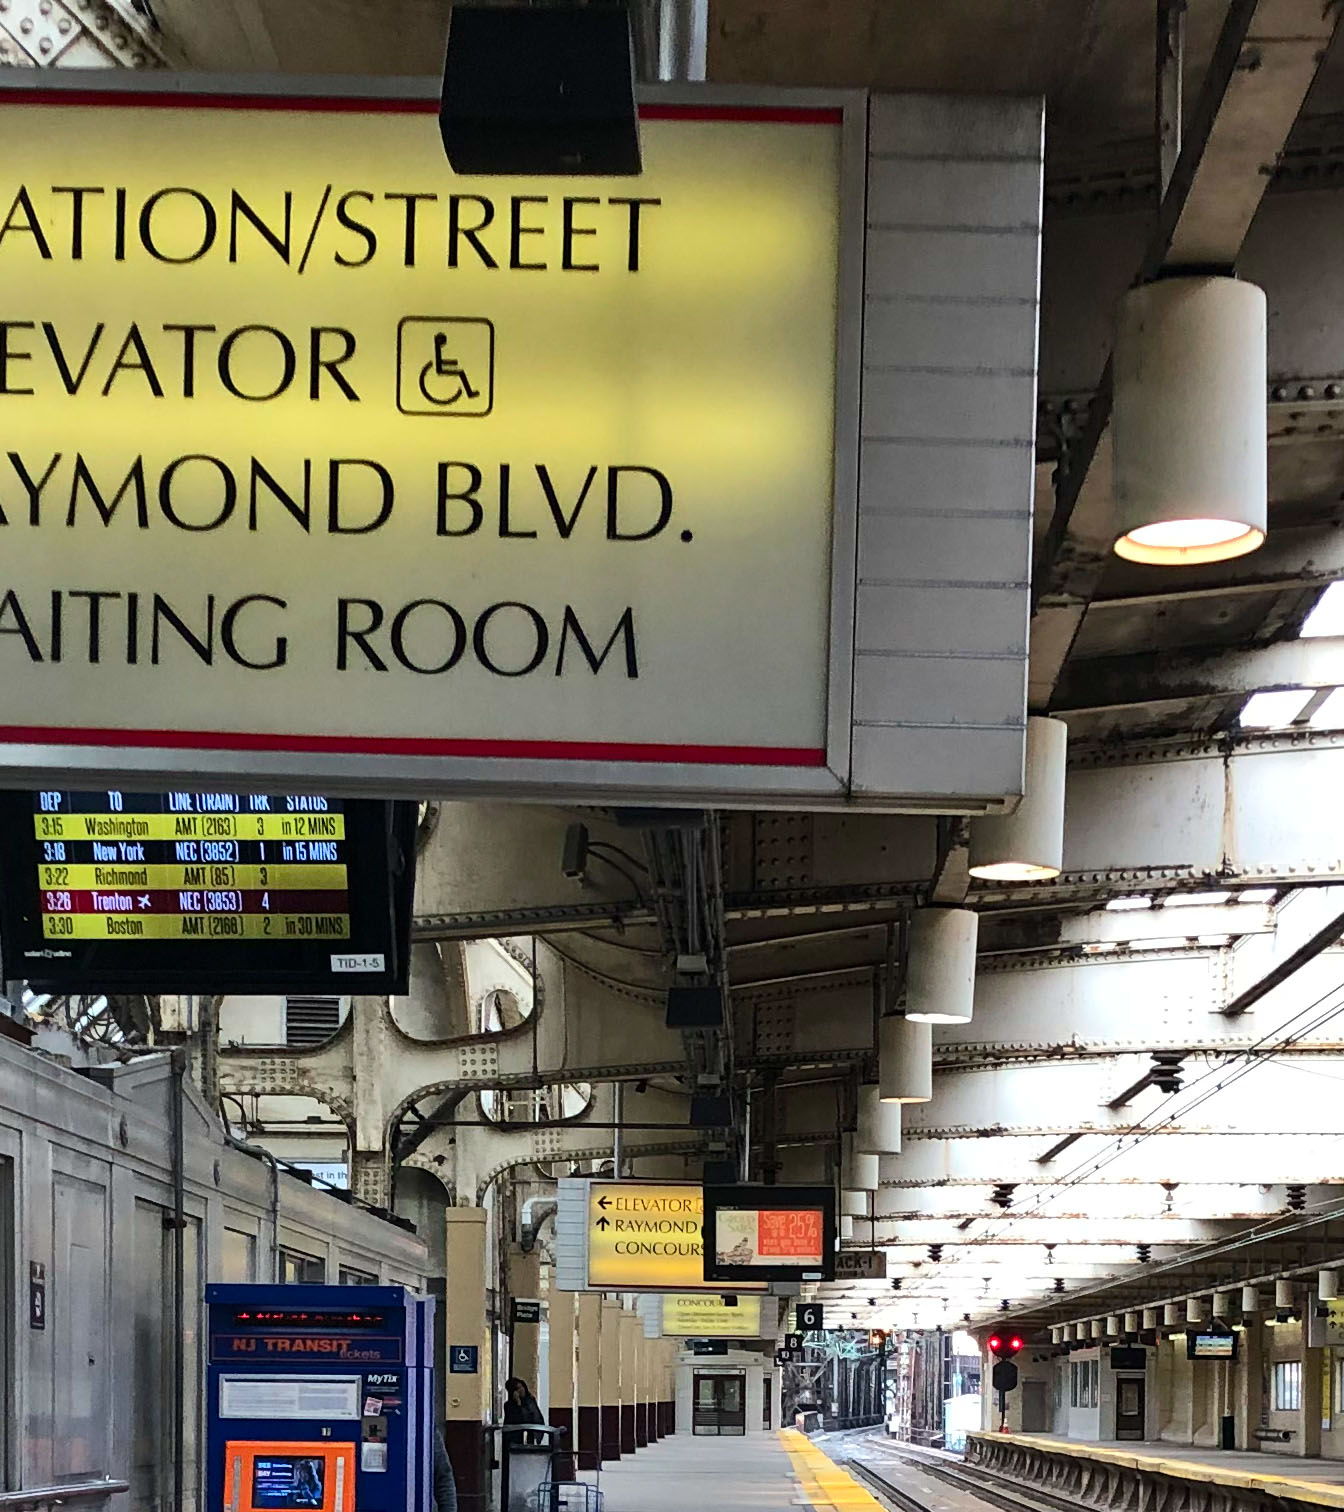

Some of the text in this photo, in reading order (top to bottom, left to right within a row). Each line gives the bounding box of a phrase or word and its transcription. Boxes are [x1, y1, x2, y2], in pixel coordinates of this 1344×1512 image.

[436, 461, 693, 543] BLVD.
[337, 597, 639, 679] ROOM
[40, 790, 329, 812] DEP TO LINE (TRAIN) TRK STATUS
[42, 816, 336, 838] 3:15 Washington AMT (2163) 3 in 12 MINS
[44, 841, 337, 862] 3:18 New York NEC (3852) 1 in 15 MINS
[45, 866, 268, 886] 3:22 Richmond AMT (85) 3
[91, 892, 132, 911] Trenton
[179, 892, 200, 911] NEC
[204, 891, 243, 912] (3853)
[262, 892, 270, 910] 4
[49, 917, 73, 935] 3:30
[107, 917, 143, 935] Boston
[182, 917, 204, 935] AMT
[263, 917, 271, 935] 2
[285, 917, 295, 935] in
[298, 917, 312, 935] 30
[315, 917, 343, 935] MINS
[337, 958, 379, 969] TID-1-5
[615, 1197, 692, 1213] ELEVATOR
[615, 1219, 698, 1234] RAYMOND
[789, 1213, 817, 1238] 25%
[803, 1309, 815, 1325] 6
[232, 1338, 352, 1352] NJ TRANSIT
[789, 1337, 798, 1349] 8
[340, 1349, 381, 1360] tickets
[367, 1374, 398, 1385] MyTix
